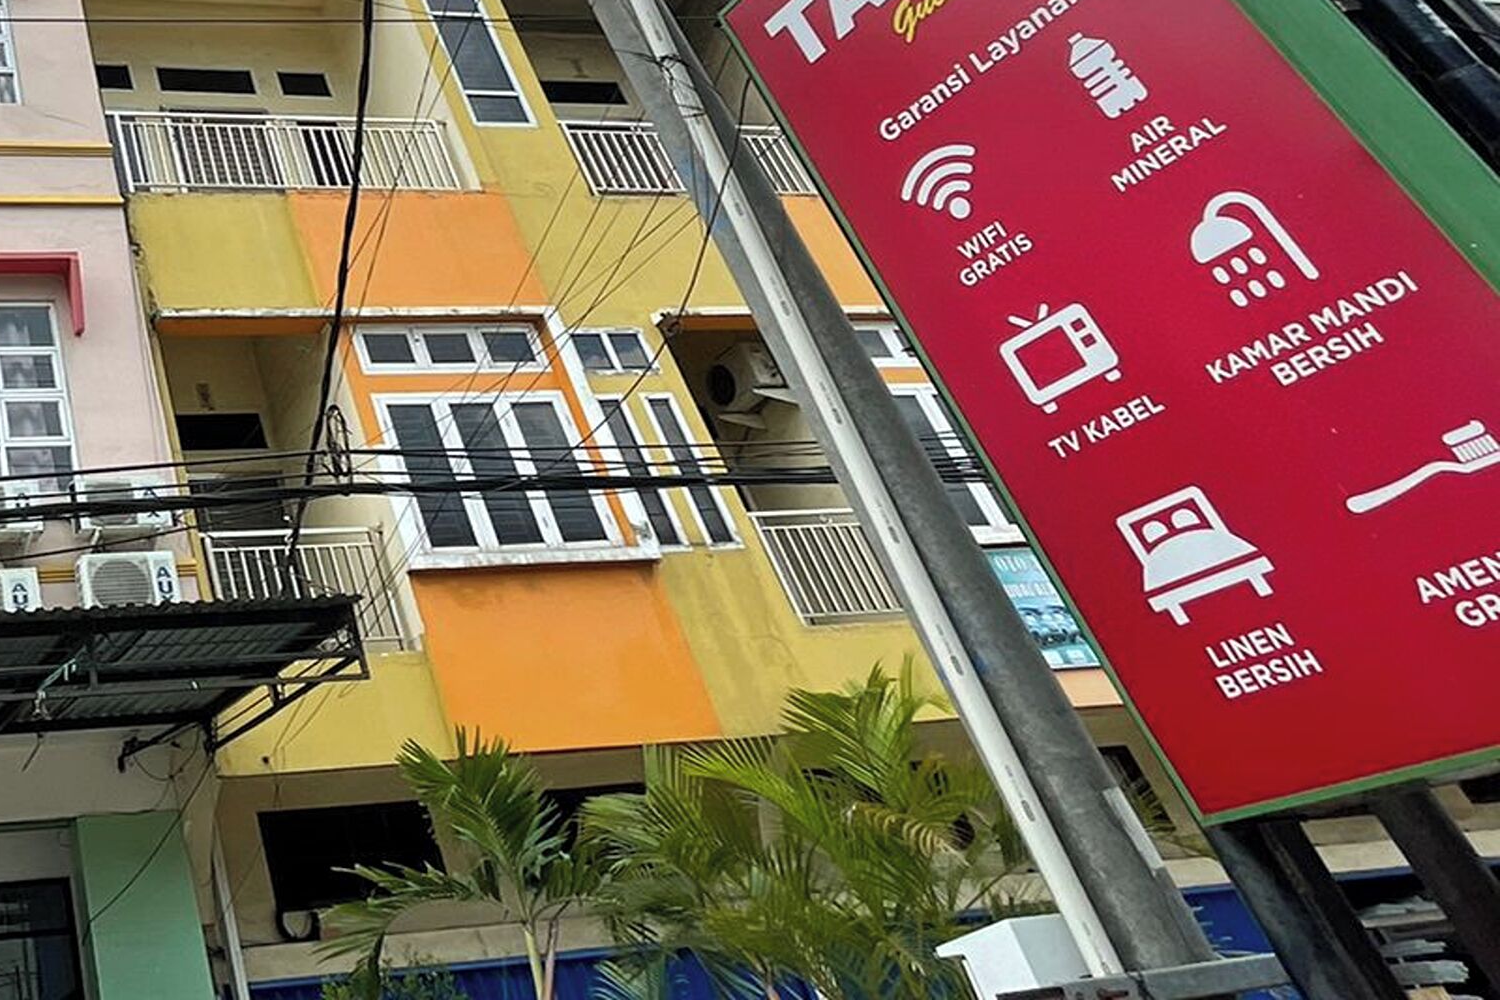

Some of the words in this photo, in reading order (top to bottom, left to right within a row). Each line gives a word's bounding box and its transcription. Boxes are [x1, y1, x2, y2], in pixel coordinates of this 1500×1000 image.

[878, 65, 972, 141] Garansi
[1110, 117, 1228, 193] MINERAL
[1130, 115, 1176, 154] AIR
[956, 220, 1008, 260] WIFI
[958, 232, 1034, 287] GRATIS
[1204, 322, 1313, 384] KAMAR
[1307, 270, 1419, 335] MANDI
[1269, 321, 1385, 387] BERSIH
[1047, 429, 1081, 459] TV
[1081, 394, 1166, 444] KABEL
[10, 582, 30, 608] AU
[1204, 622, 1295, 669] LINEN
[1215, 648, 1324, 700] BERSIH
